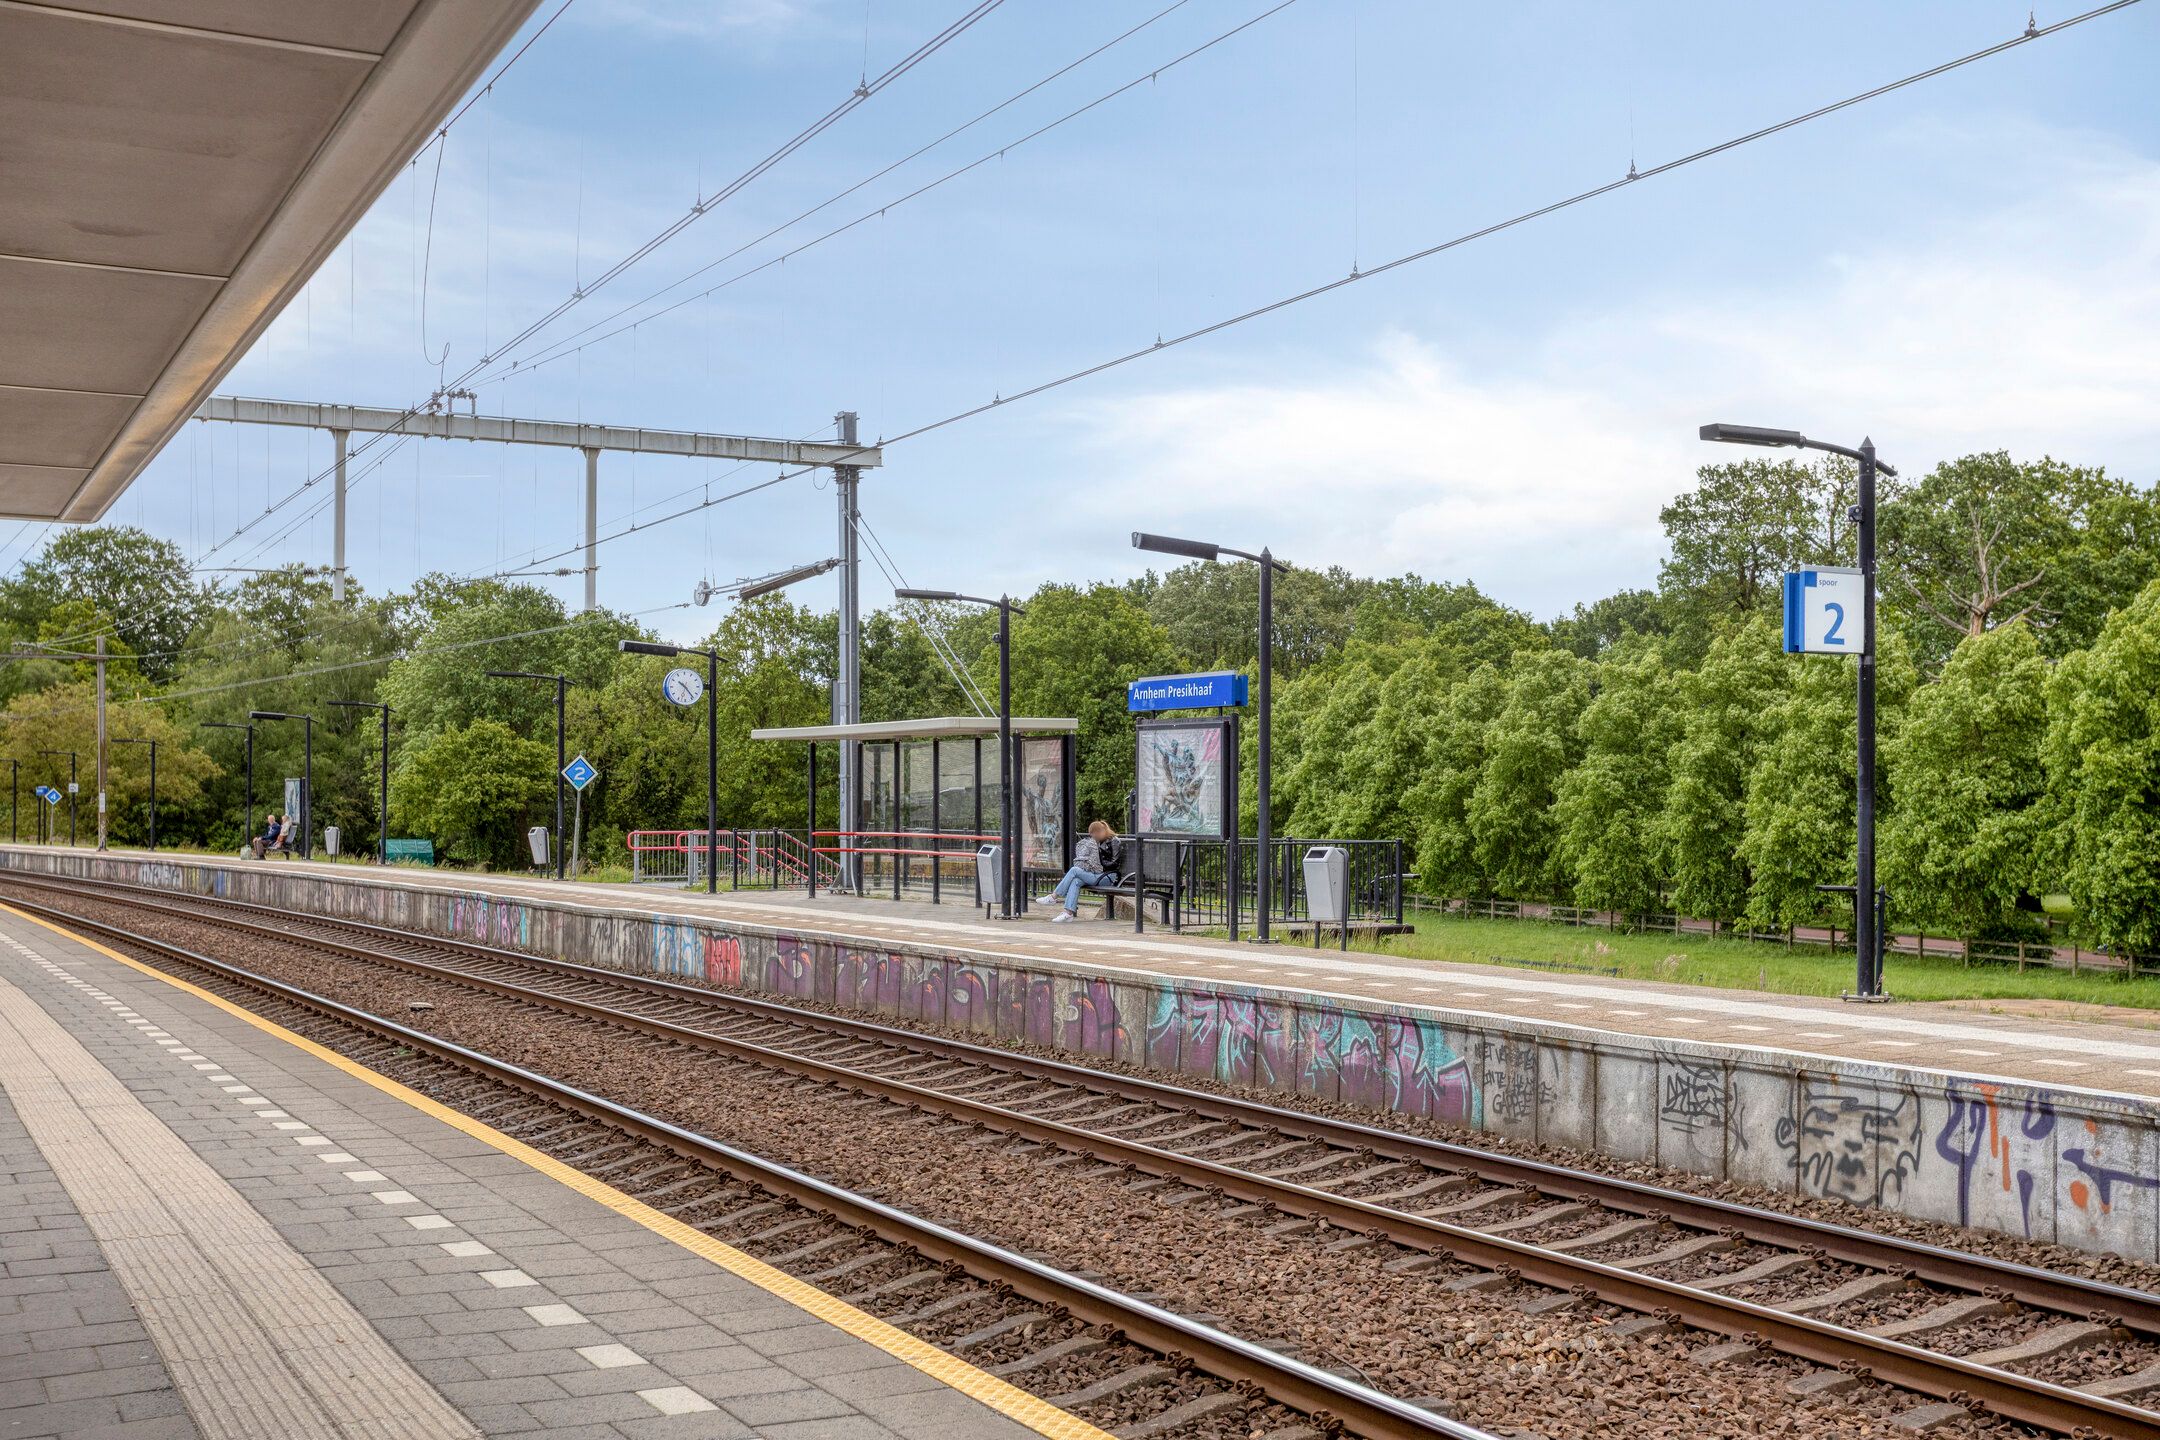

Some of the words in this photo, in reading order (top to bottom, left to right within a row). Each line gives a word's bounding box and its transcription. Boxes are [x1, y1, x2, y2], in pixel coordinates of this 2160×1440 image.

[1818, 579, 1838, 587] spoor
[1823, 602, 1845, 646] 2
[1133, 687, 1166, 700] Arnhem
[1168, 682, 1213, 698] Presikhaaf
[573, 766, 585, 781] 2
